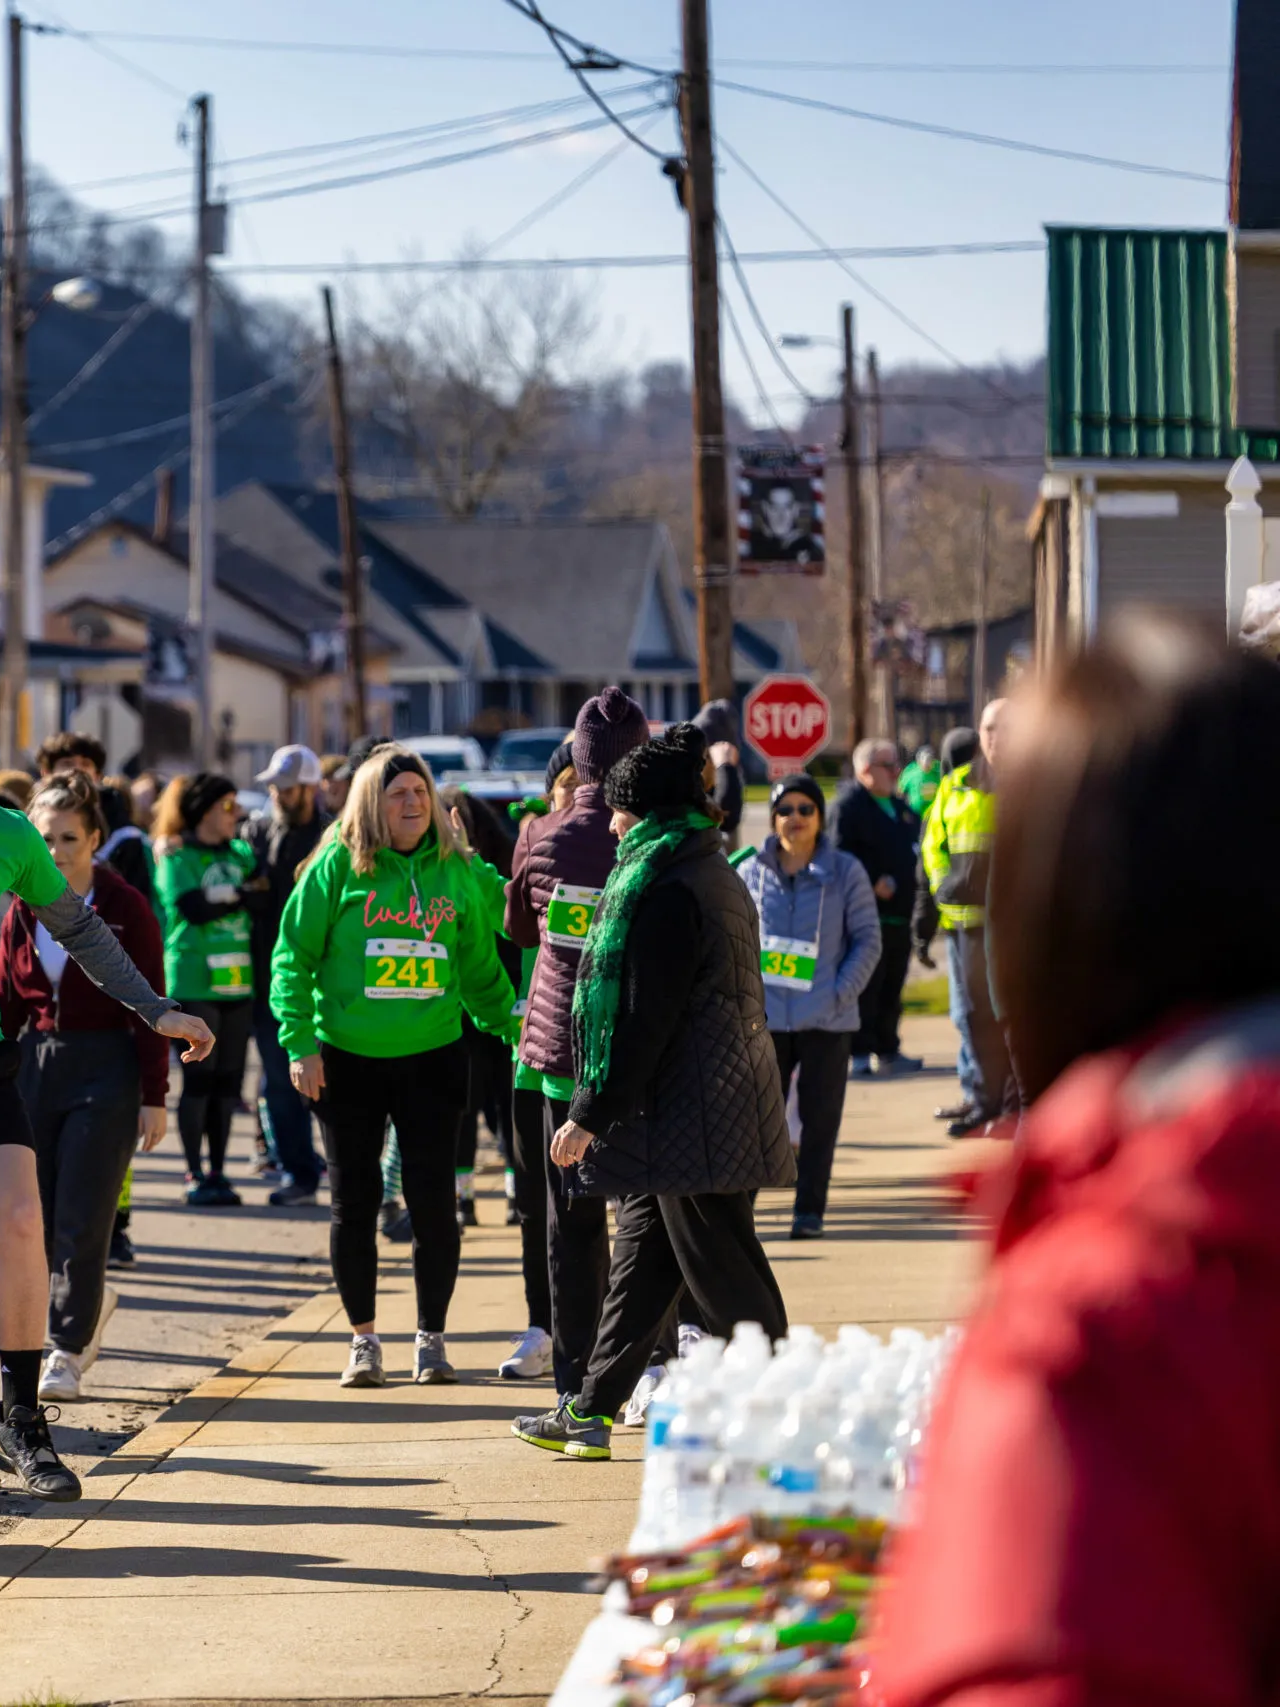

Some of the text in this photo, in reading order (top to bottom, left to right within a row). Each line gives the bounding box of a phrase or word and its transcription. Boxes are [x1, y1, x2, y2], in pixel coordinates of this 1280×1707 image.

[750, 702, 823, 739] STOP
[375, 956, 439, 988] 241
[765, 951, 798, 977] 35
